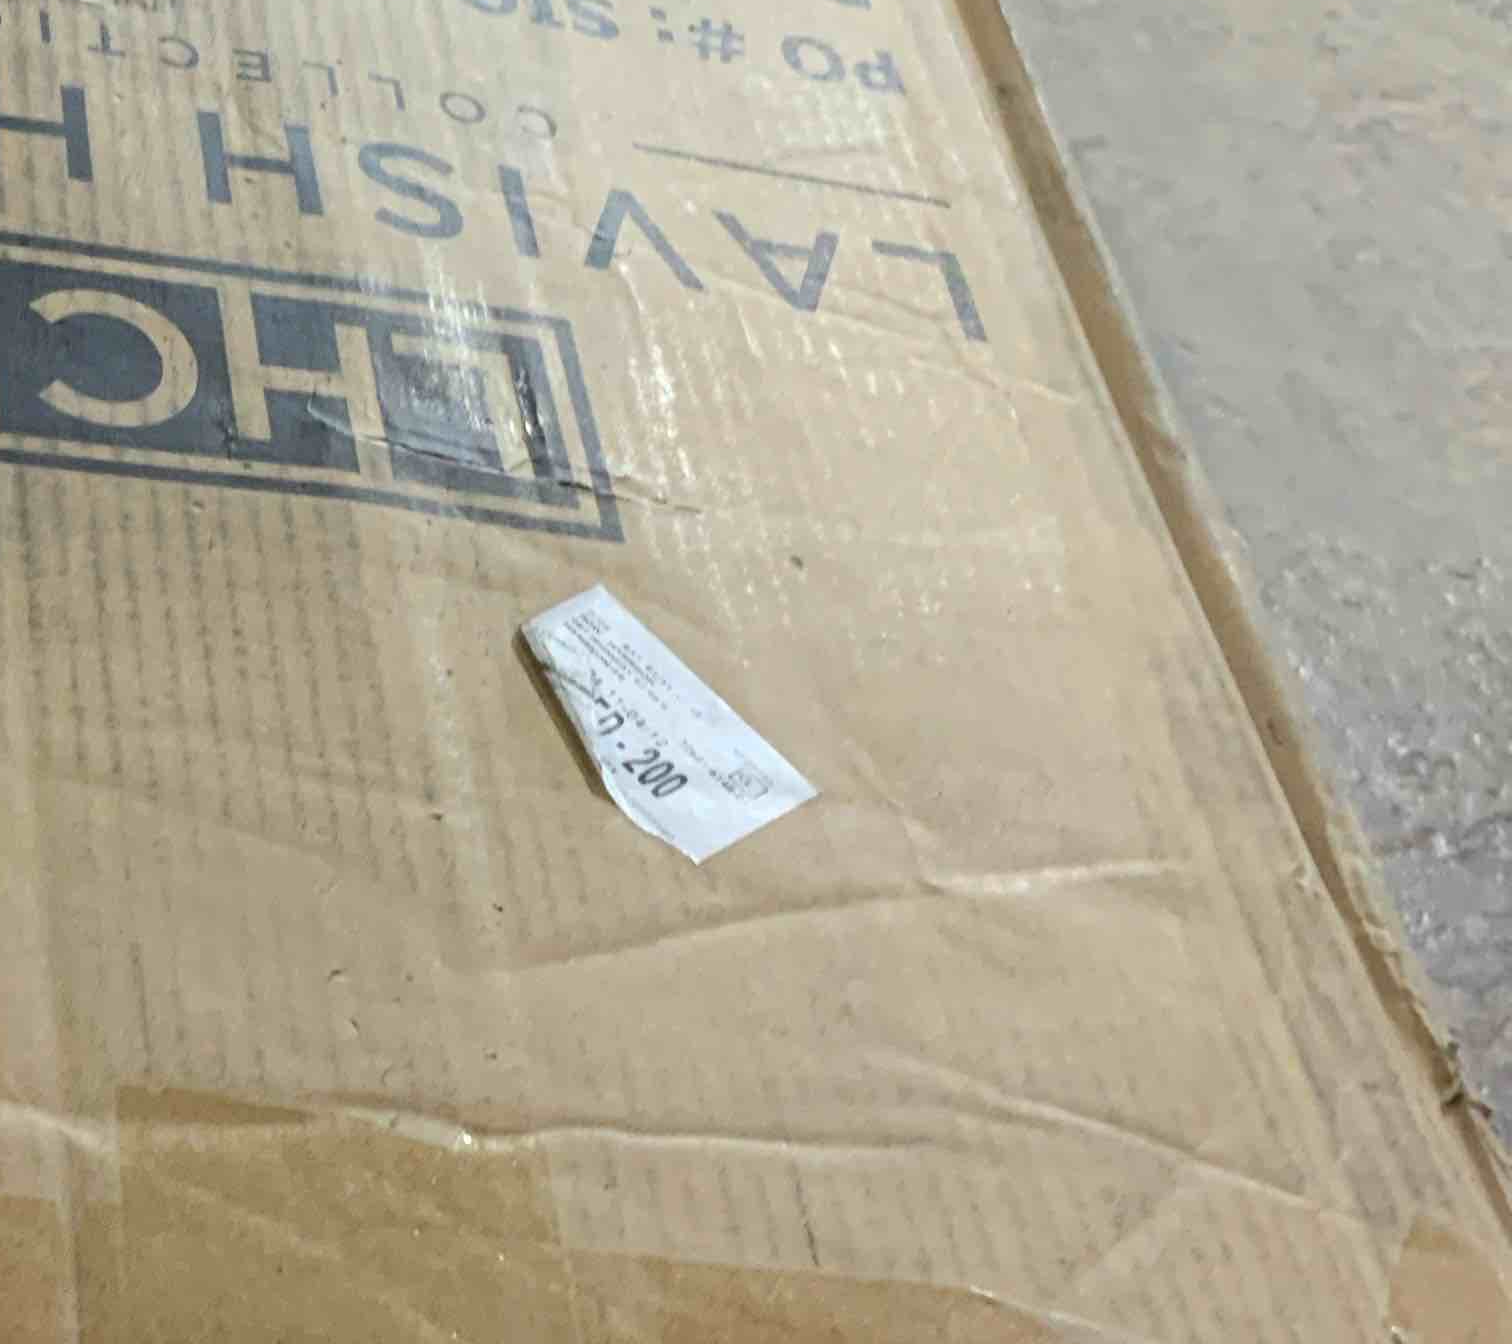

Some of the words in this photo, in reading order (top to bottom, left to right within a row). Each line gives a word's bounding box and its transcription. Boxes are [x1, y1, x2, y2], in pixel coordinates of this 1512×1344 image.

[781, 35, 906, 96] PO
[197, 110, 987, 342] LAVISH
[28, 287, 536, 483] LHC
